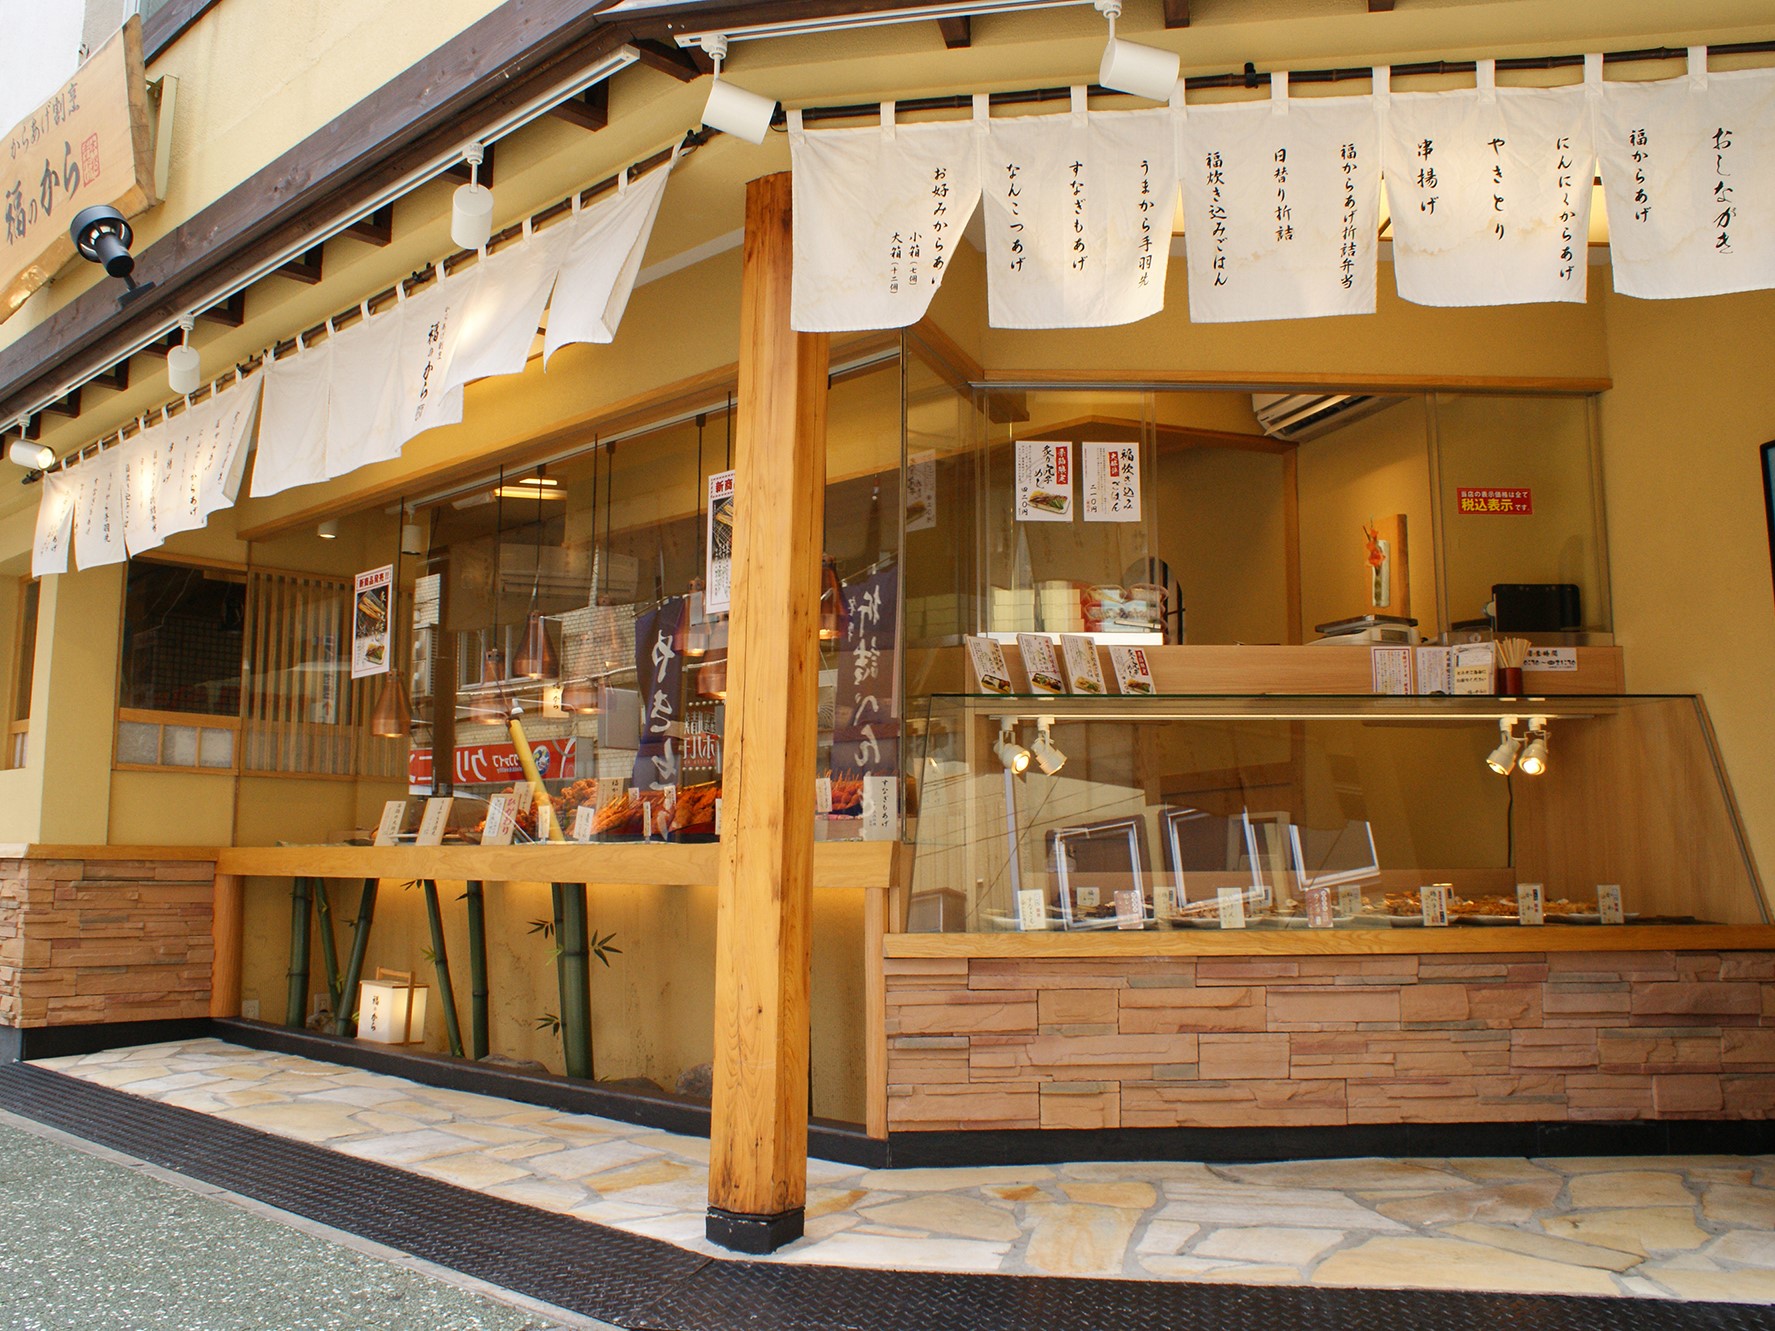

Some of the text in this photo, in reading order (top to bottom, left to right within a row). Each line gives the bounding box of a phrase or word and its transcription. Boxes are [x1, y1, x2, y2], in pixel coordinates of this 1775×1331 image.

[5, 140, 81, 245] 福のから
[1006, 163, 1026, 272] なんこつあげ
[1069, 160, 1088, 271] すなぎもあげ
[1137, 160, 1154, 288] うまから手羽先
[1205, 151, 1229, 287] 福炊き込みごはん
[1274, 148, 1295, 242] 日替り折詰
[1340, 143, 1358, 290] 福からあげ折詰弁当
[1417, 138, 1440, 215] 串揚げ
[1487, 138, 1505, 240] やきとり
[1557, 136, 1576, 281] にんにくからあげ
[1629, 128, 1652, 223] 福からあげ
[1712, 127, 1737, 255] おしながき
[715, 478, 734, 493] 新商
[881, 779, 890, 828] すなぎもあげ
